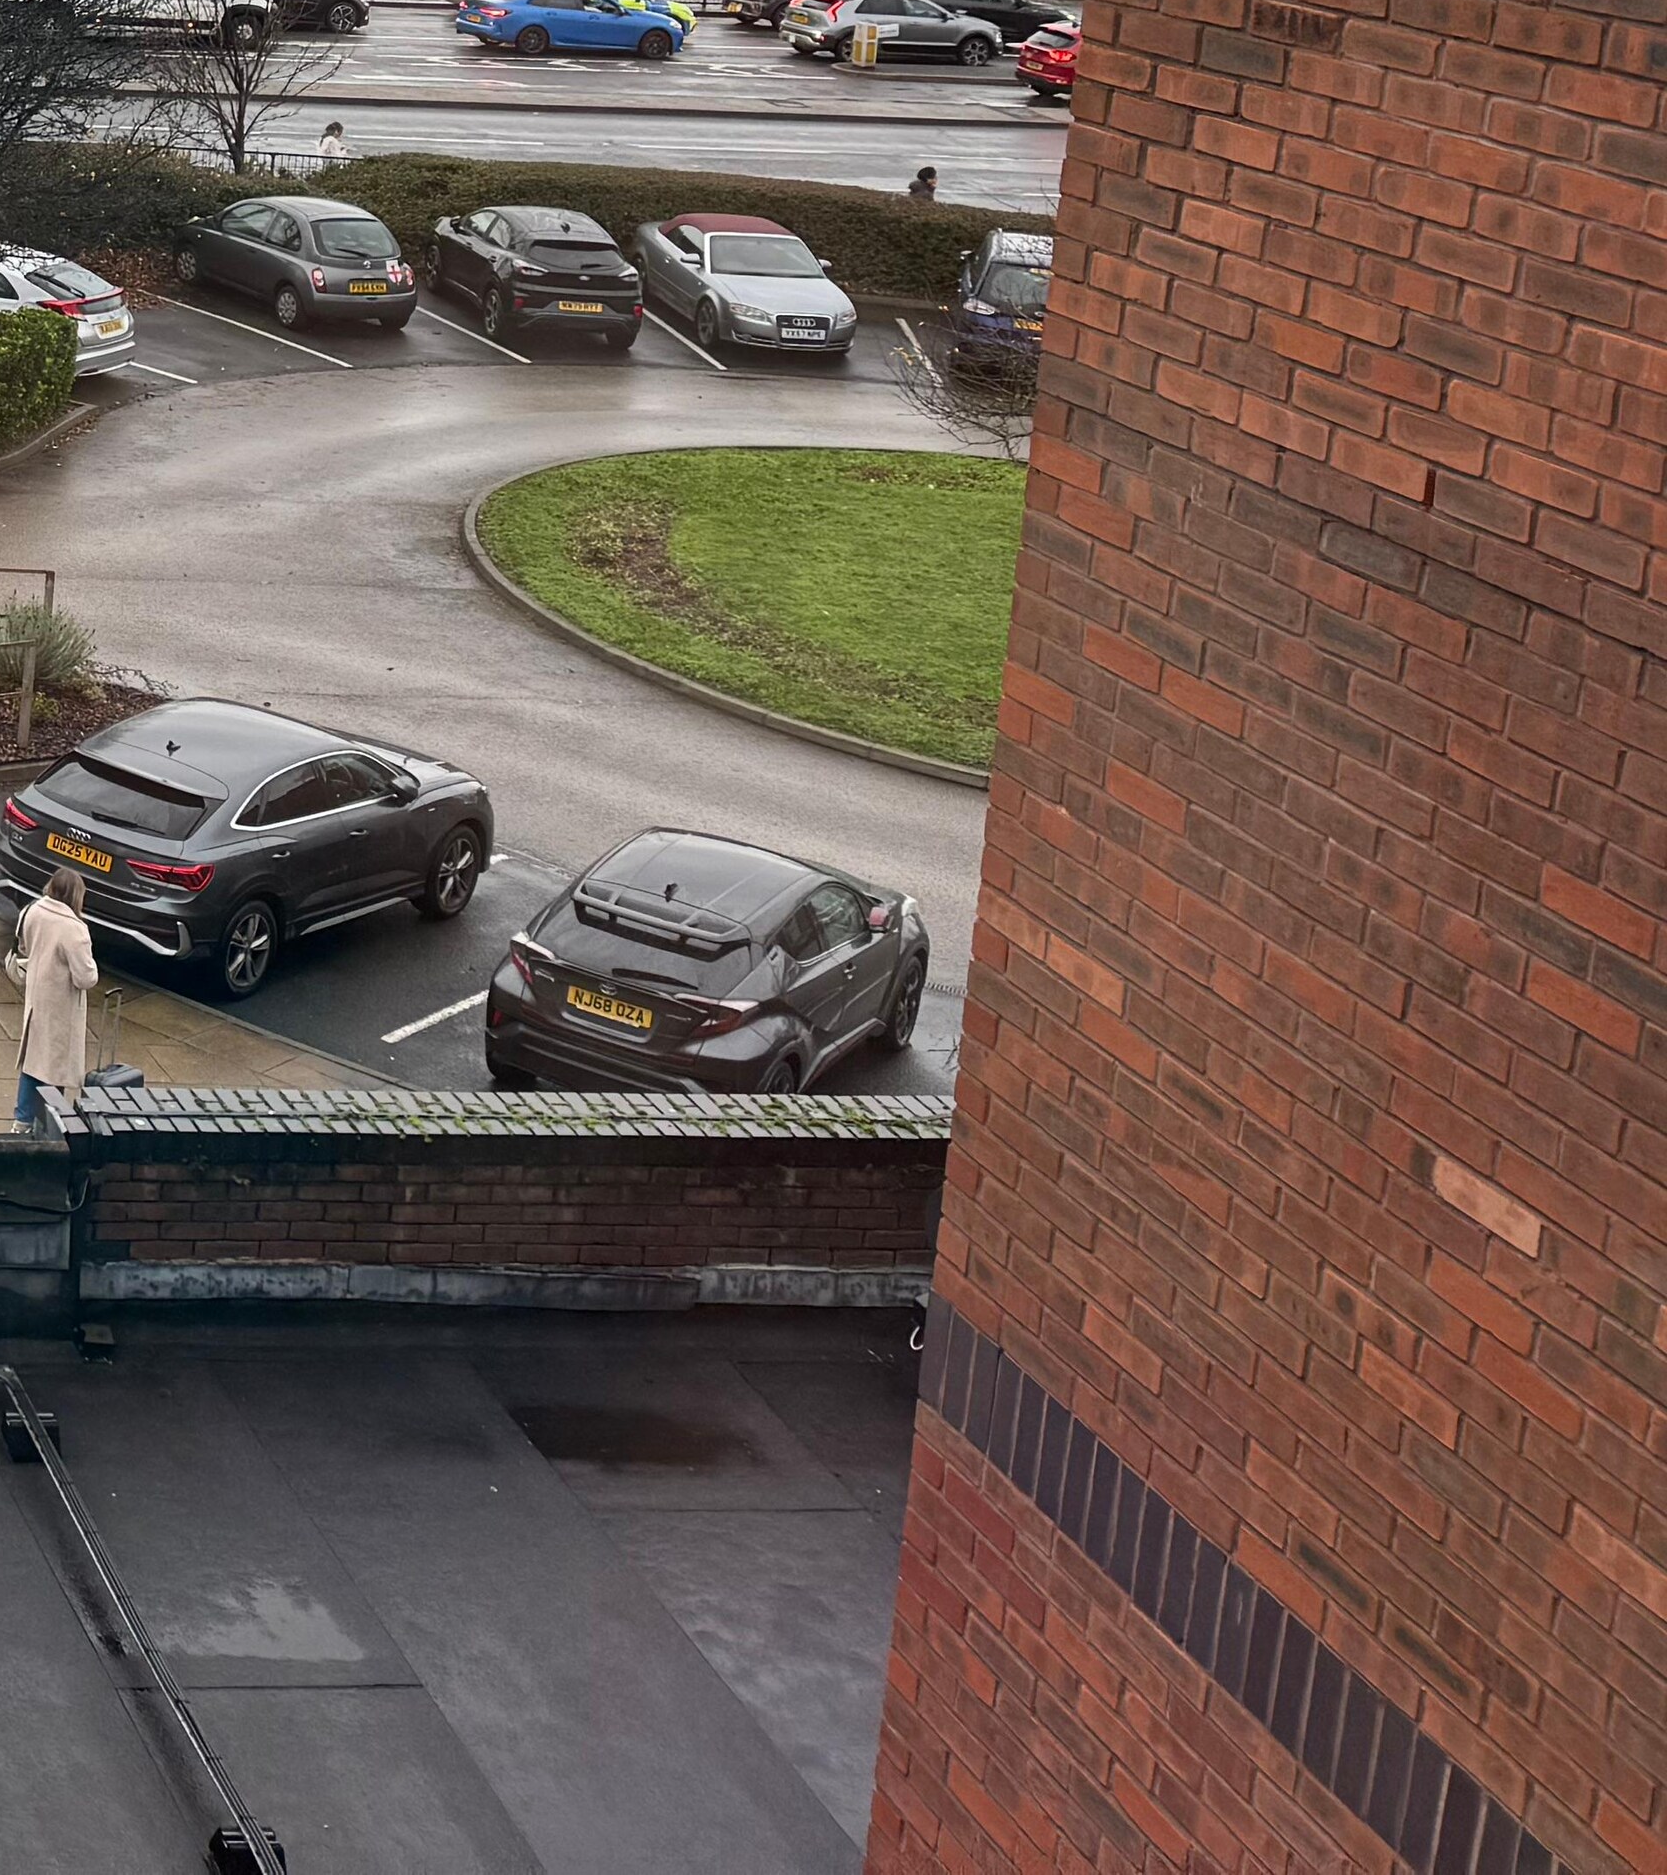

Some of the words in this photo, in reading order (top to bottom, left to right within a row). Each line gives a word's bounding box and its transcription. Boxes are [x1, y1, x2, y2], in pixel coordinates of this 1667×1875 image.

[52, 836, 82, 858] DG25
[84, 848, 108, 868] YAU
[574, 989, 613, 1013] NJ68
[616, 1002, 644, 1024] OZA
